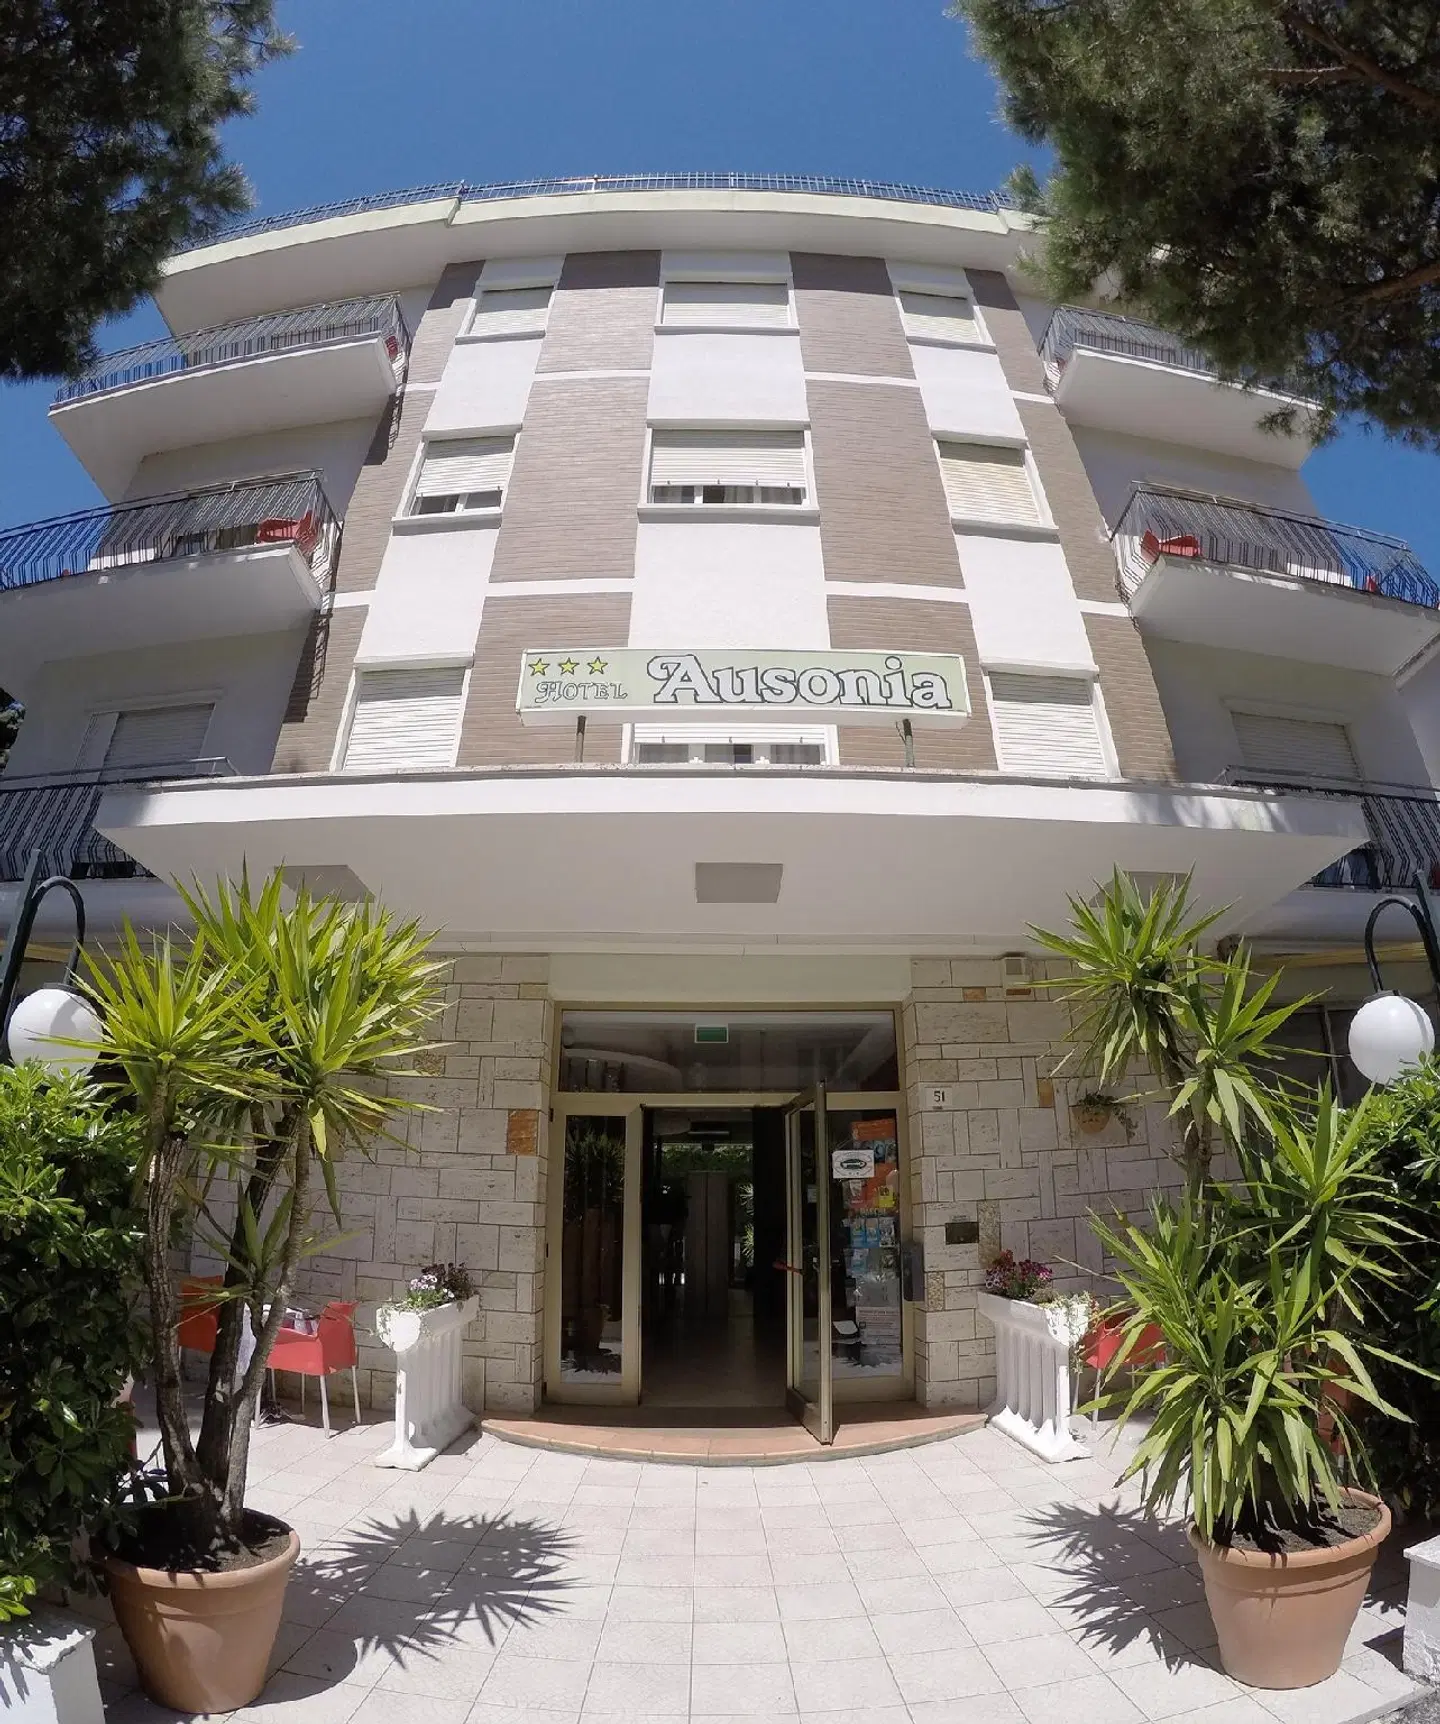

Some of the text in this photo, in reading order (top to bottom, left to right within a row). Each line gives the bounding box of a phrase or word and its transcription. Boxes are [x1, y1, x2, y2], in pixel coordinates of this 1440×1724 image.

[534, 681, 628, 704] HOTEL
[647, 654, 953, 709] Ausonia
[933, 1090, 945, 1102] 51
